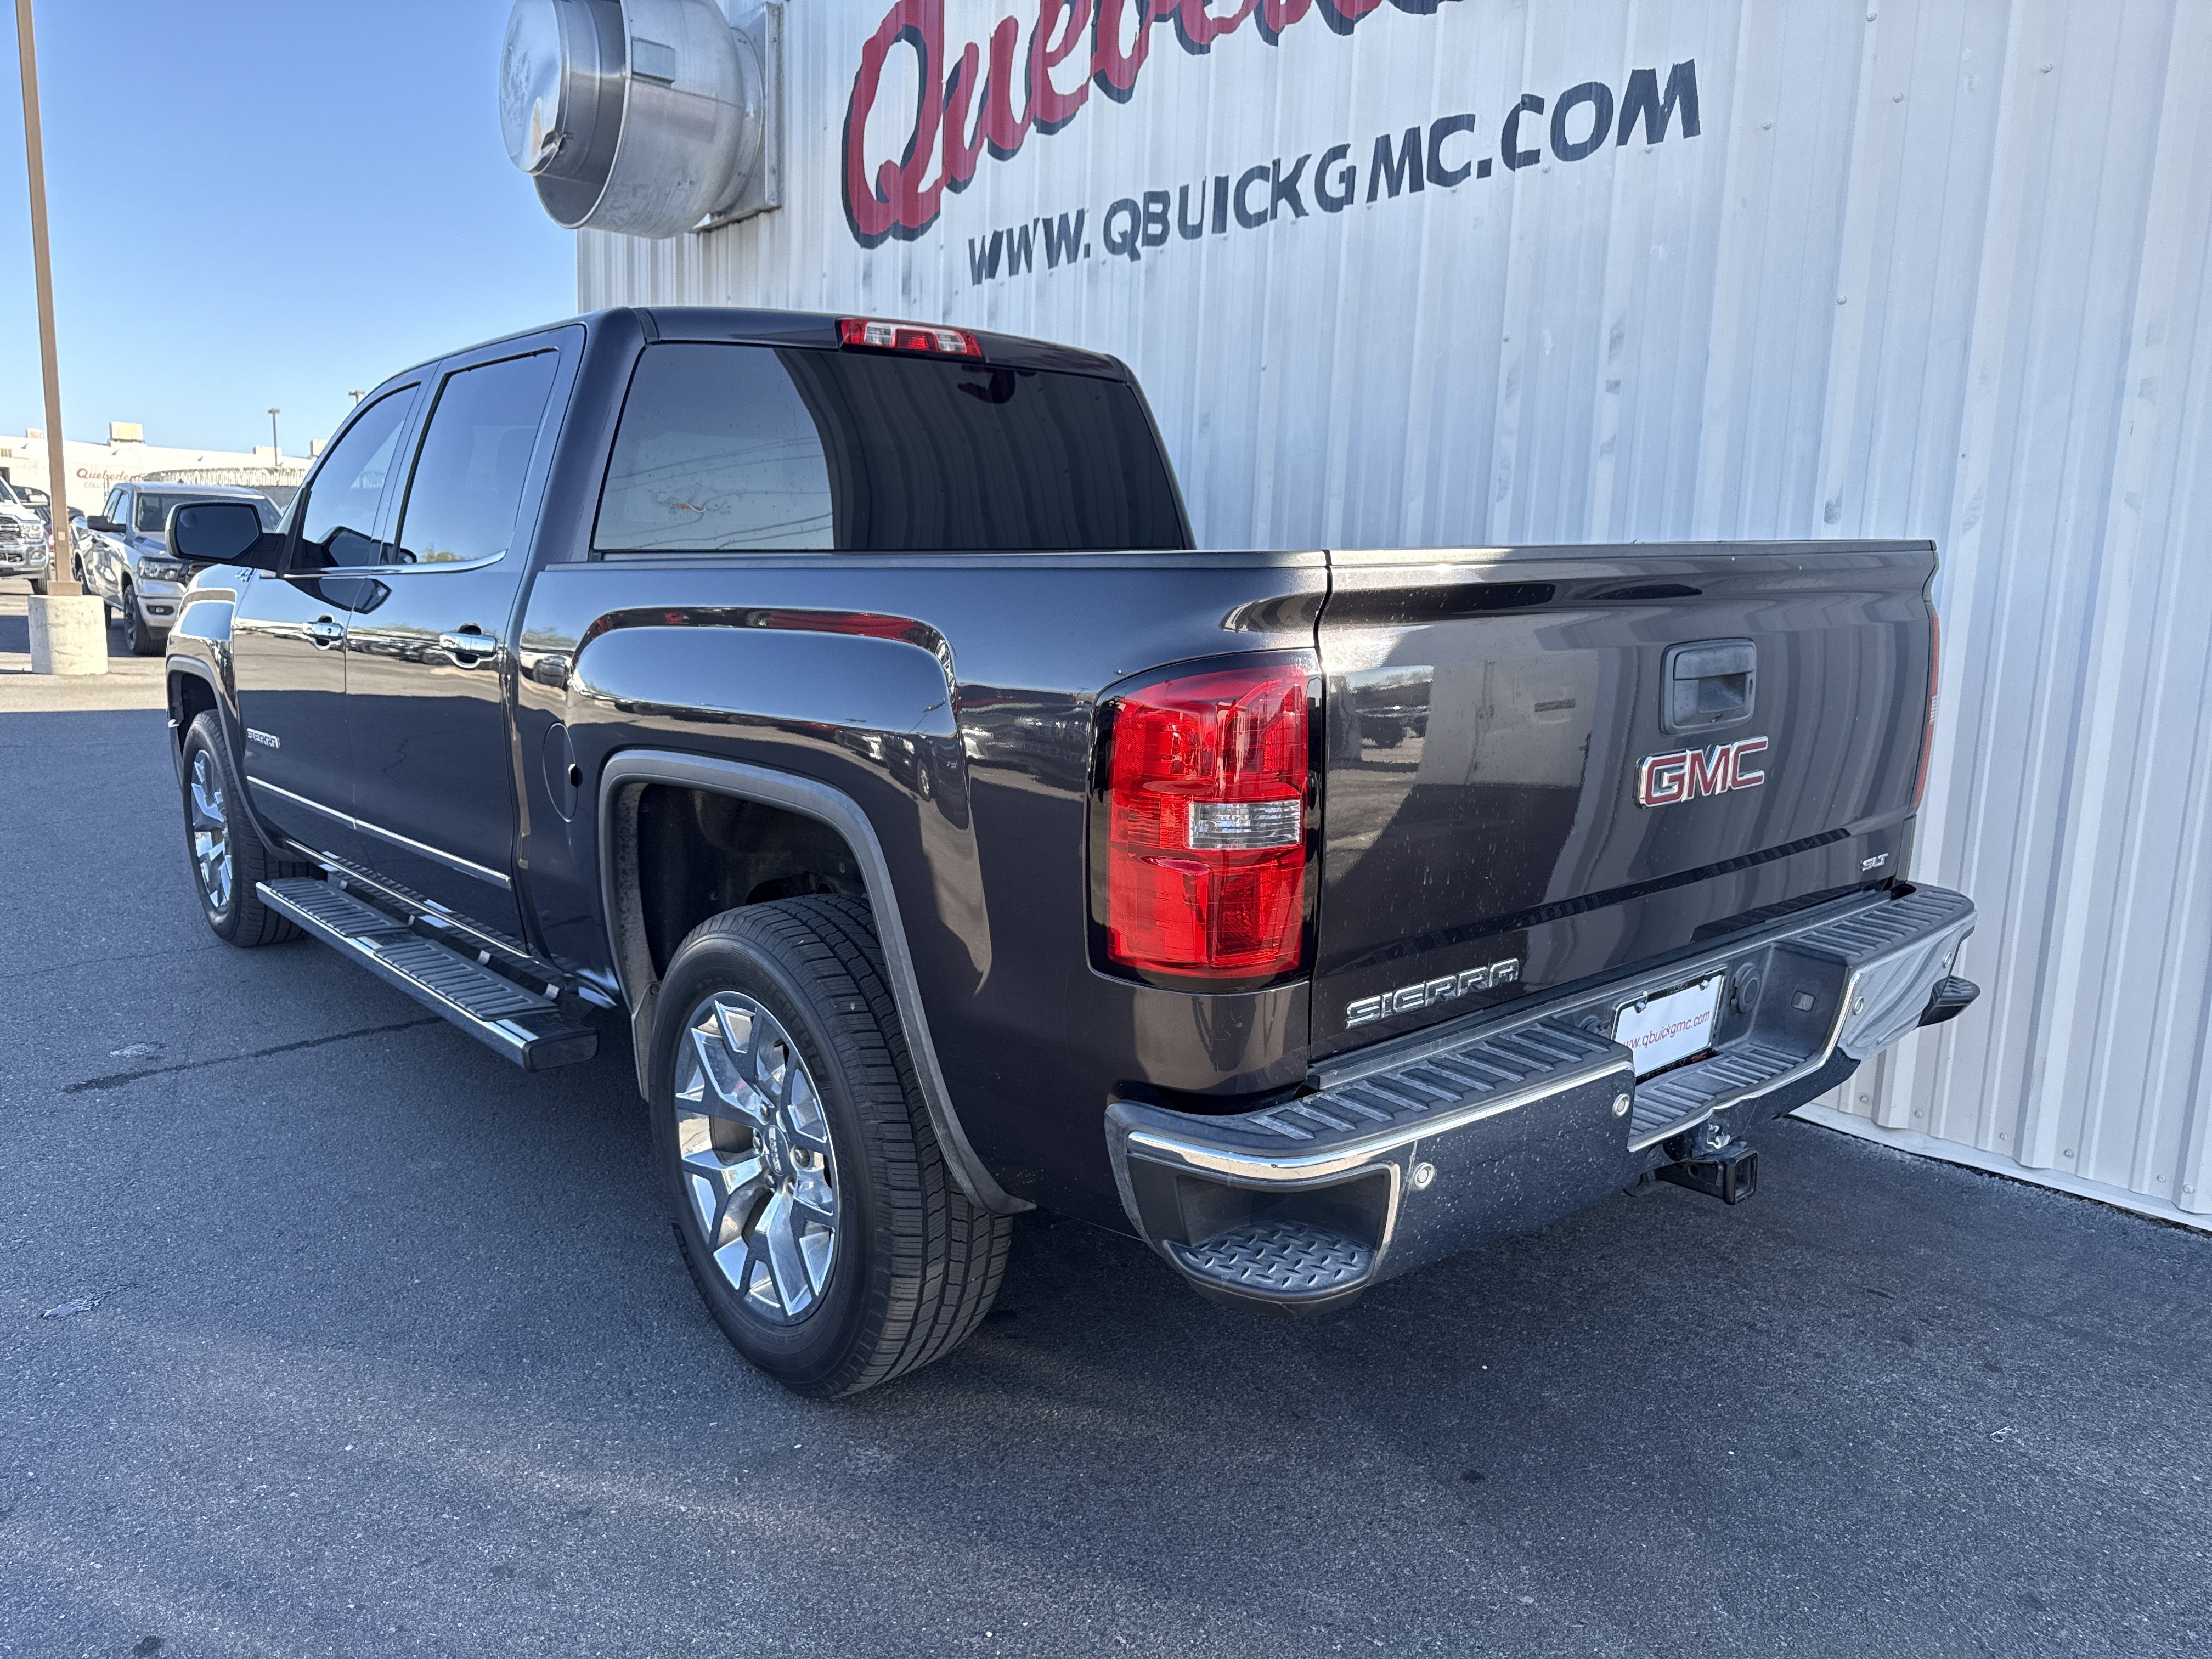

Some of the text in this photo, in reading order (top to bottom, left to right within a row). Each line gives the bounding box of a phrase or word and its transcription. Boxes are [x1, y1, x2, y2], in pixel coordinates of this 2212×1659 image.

[1637, 736, 1769, 809] GMC
[1862, 853, 1888, 872] SLT
[1346, 958, 1519, 1029] SIERRA
[1622, 1011, 1710, 1048] ww.qbuickgmc.com
